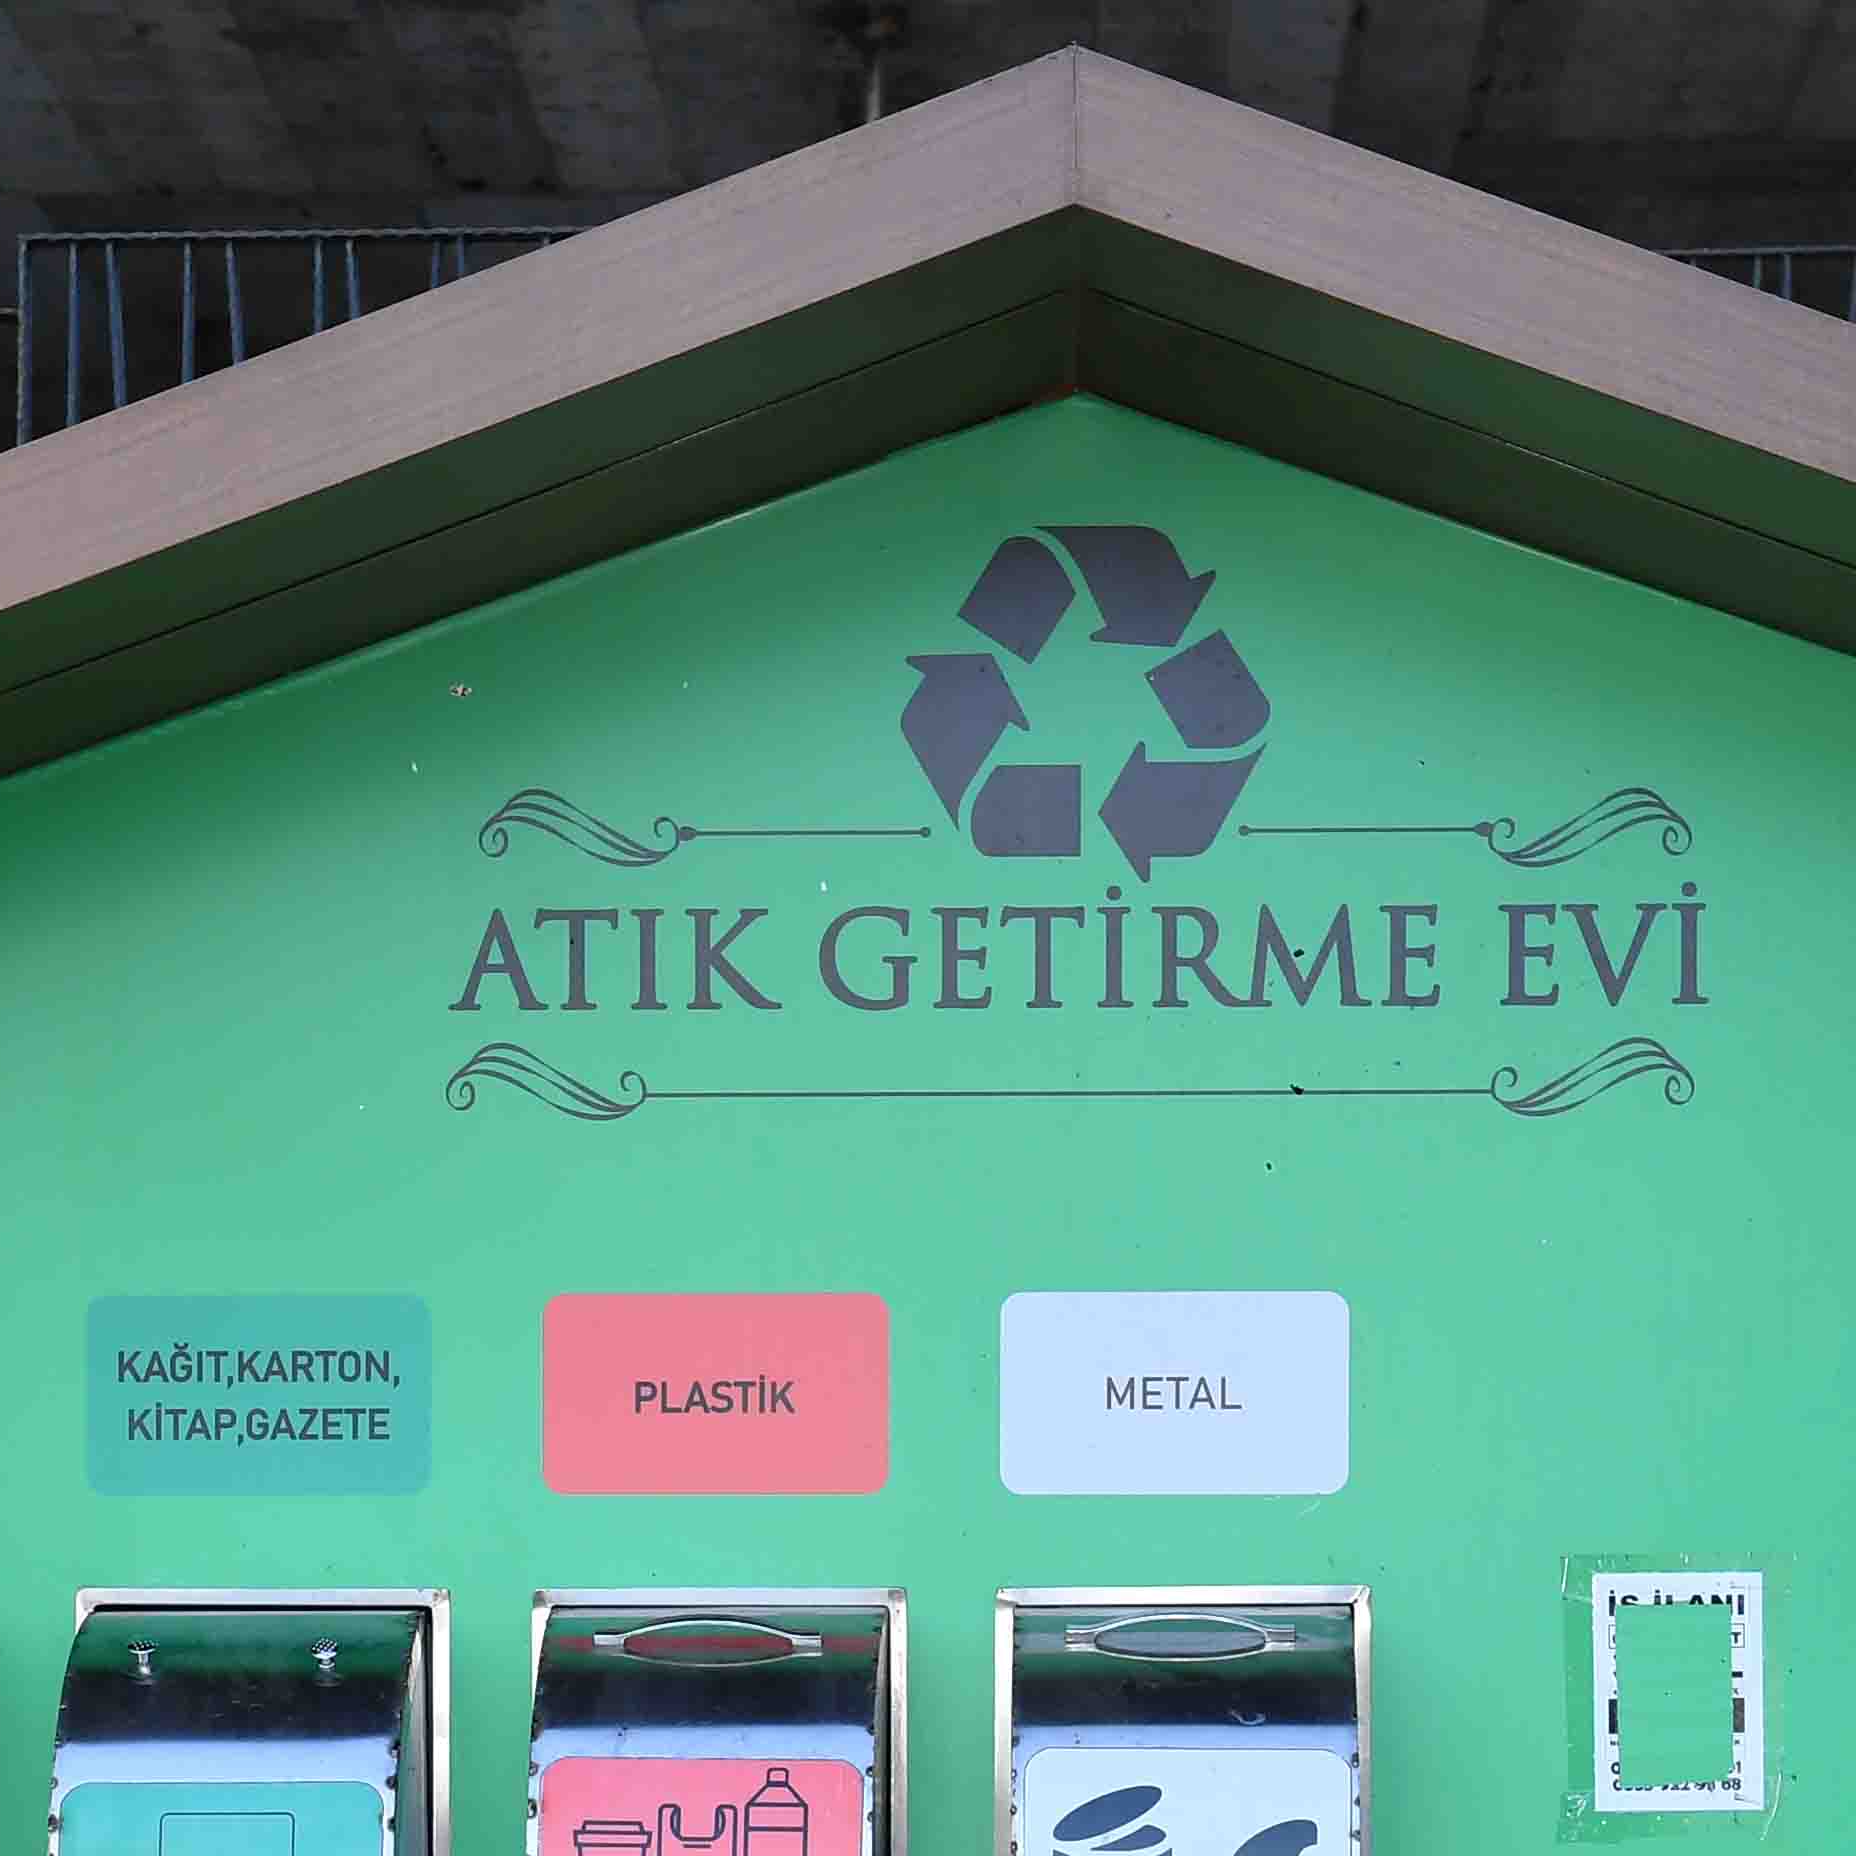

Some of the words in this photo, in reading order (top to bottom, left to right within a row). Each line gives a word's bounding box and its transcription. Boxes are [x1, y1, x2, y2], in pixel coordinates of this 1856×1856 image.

[448, 906, 784, 1011] ATIK
[817, 884, 1441, 1011] GETİRME
[1496, 880, 1711, 1009] EVİ
[117, 1342, 401, 1390] KAĞIT,KARTON,
[634, 1373, 796, 1414] PLASTİK
[1106, 1375, 1243, 1411] METAL
[128, 1401, 391, 1447] KİTAP,GAZETE
